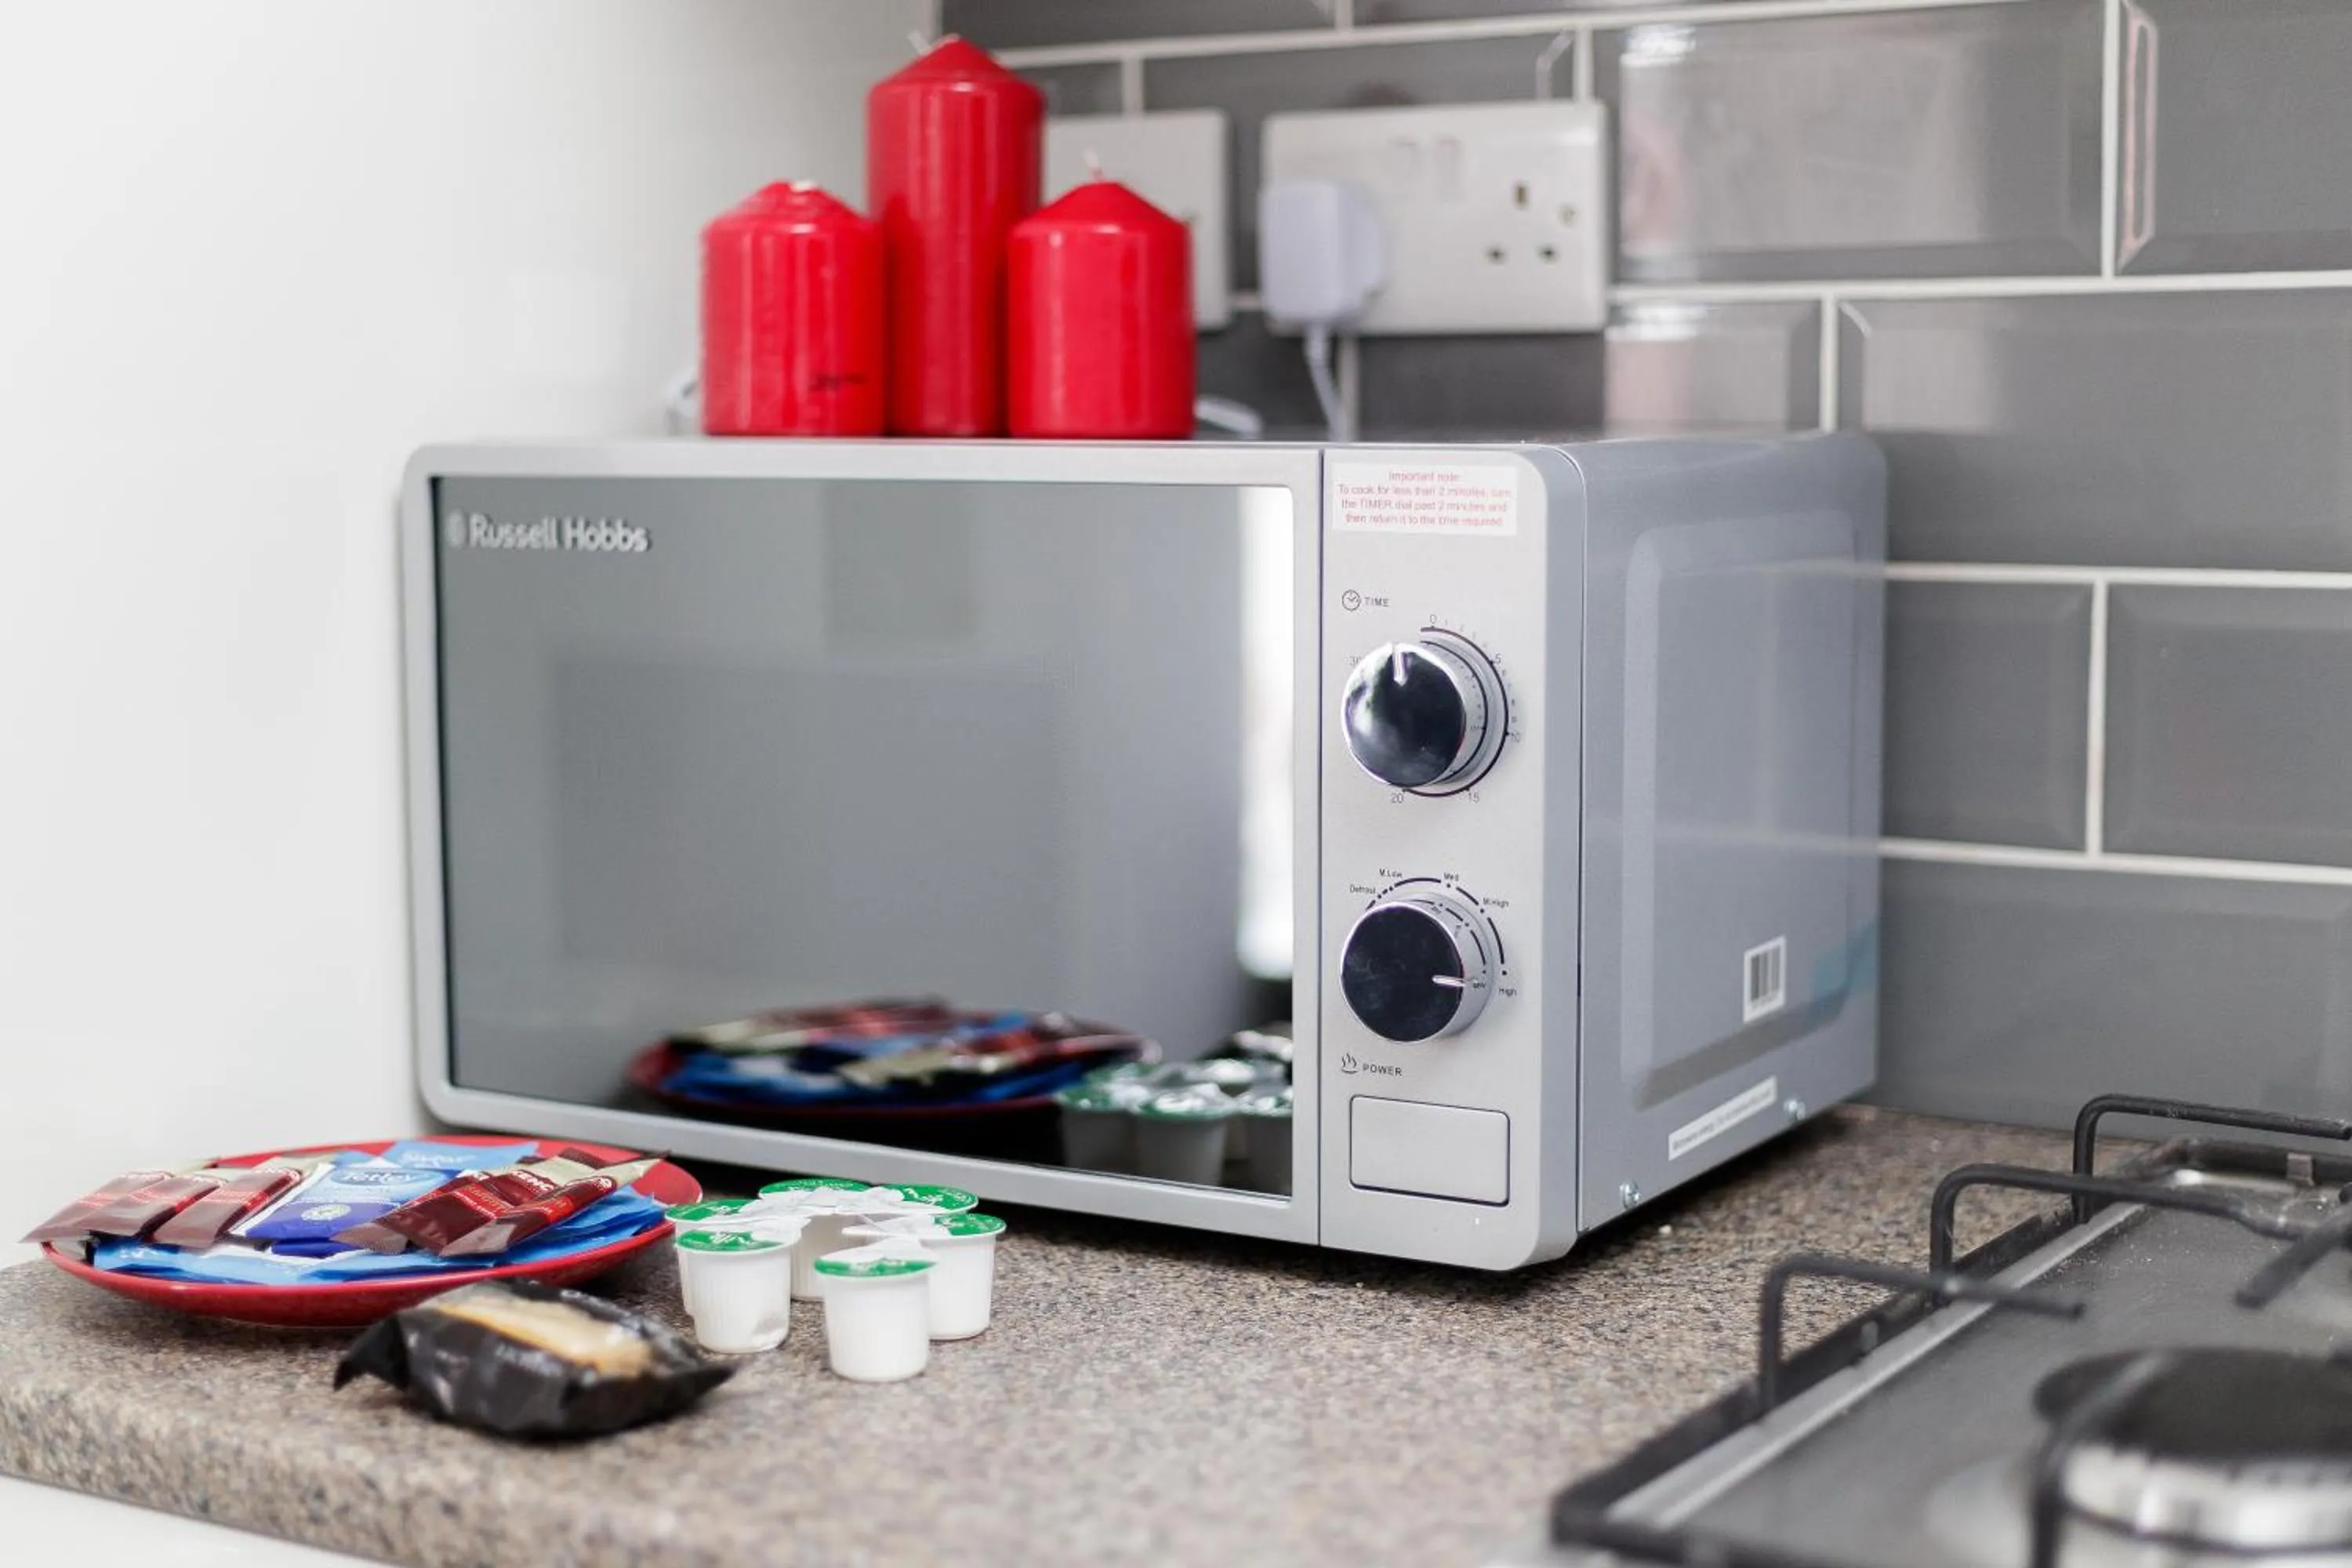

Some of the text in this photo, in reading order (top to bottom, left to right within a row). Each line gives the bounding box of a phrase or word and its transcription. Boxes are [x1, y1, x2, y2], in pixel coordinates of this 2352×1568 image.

[1388, 472, 1435, 483] Important
[1338, 485, 1348, 495] To
[1351, 486, 1374, 495] cook
[1377, 486, 1389, 495] for
[1341, 499, 1357, 509] the
[1360, 499, 1392, 510] TIMER
[1395, 500, 1412, 510] dial
[1414, 501, 1436, 511] past
[1346, 514, 1367, 523] then
[470, 513, 651, 552] Russell Hobbs
[1364, 597, 1390, 608] TIME
[1429, 615, 1437, 624] 0
[1494, 653, 1502, 664] 5
[1391, 793, 1404, 804] 20
[1498, 987, 1517, 997] High
[1362, 1064, 1403, 1076] POWER
